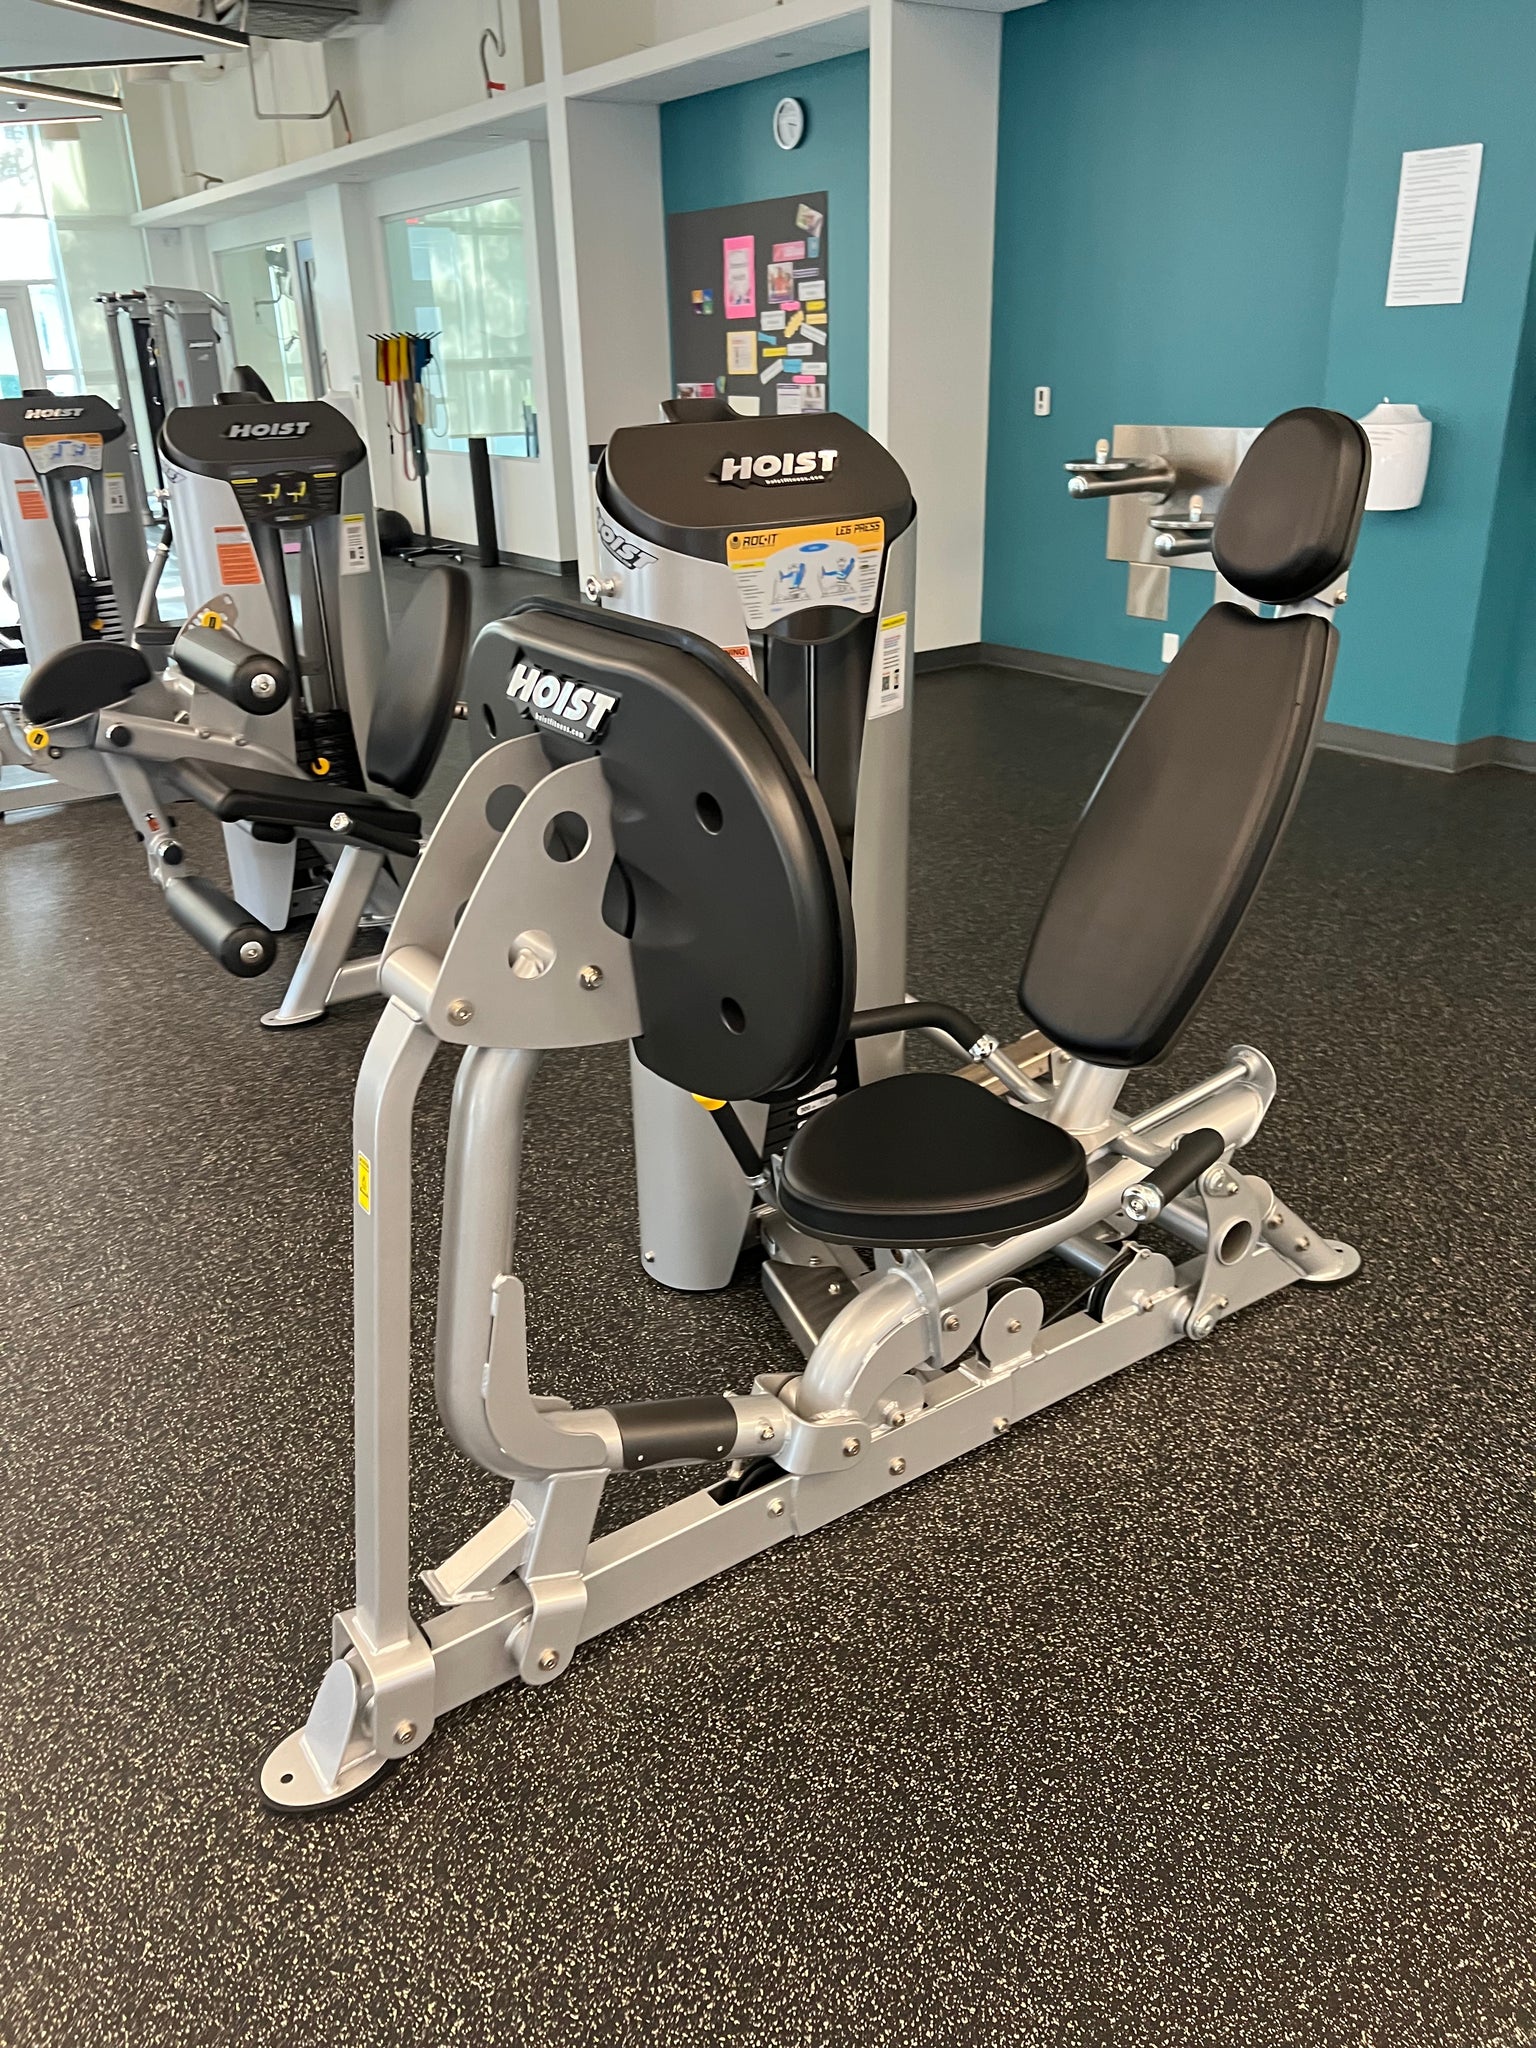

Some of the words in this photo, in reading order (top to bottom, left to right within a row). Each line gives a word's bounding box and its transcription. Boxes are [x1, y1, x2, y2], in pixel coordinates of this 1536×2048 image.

[24, 407, 85, 419] HOIST
[228, 421, 311, 438] HOIST
[720, 449, 838, 481] HOIST
[835, 524, 852, 536] LEG
[853, 520, 881, 534] PRESS
[506, 663, 616, 730] HOIST
[535, 712, 585, 739] hoistfitness.com
